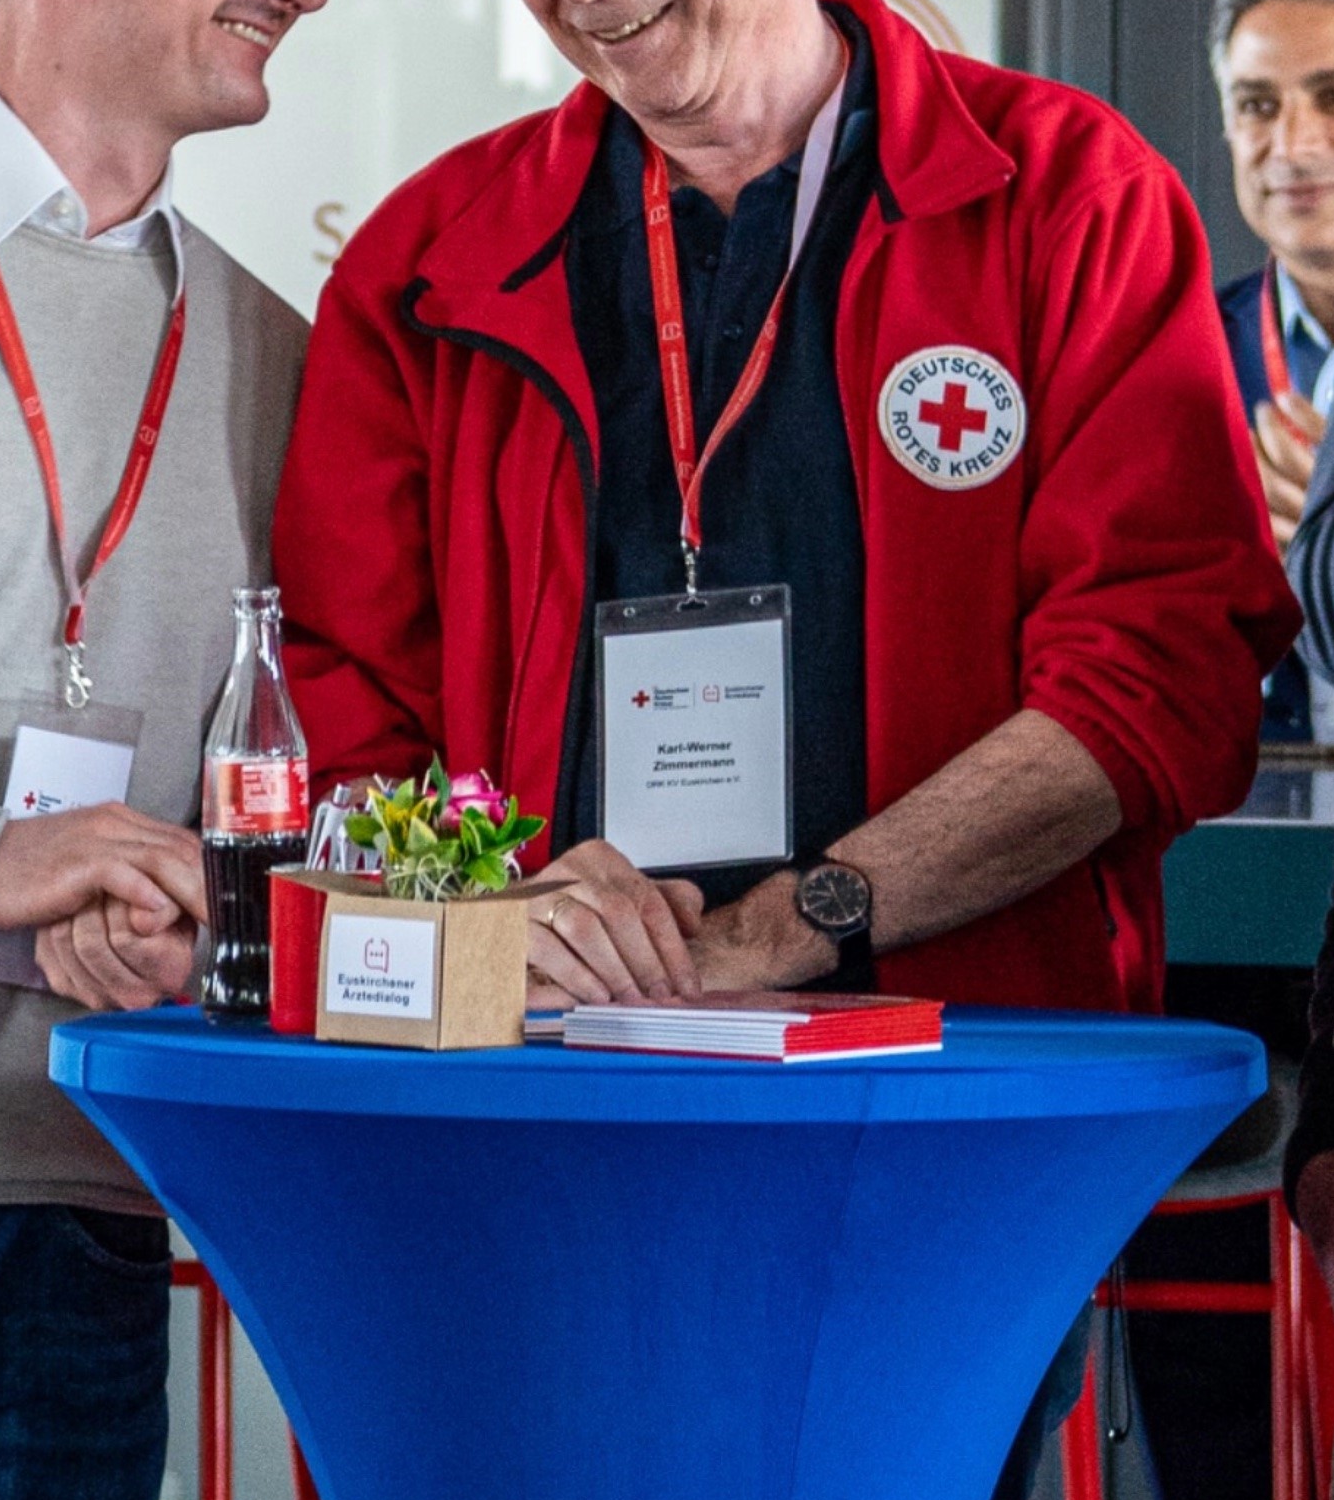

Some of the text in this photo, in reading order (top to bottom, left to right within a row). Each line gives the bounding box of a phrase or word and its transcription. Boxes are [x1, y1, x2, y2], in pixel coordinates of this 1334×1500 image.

[898, 357, 1013, 412] DEUTSCHES
[892, 410, 1013, 478] ROTES KREUZ
[657, 742, 732, 755] Karl-Werner
[652, 758, 736, 772] Zimmermann
[337, 973, 416, 990] Euskirchener
